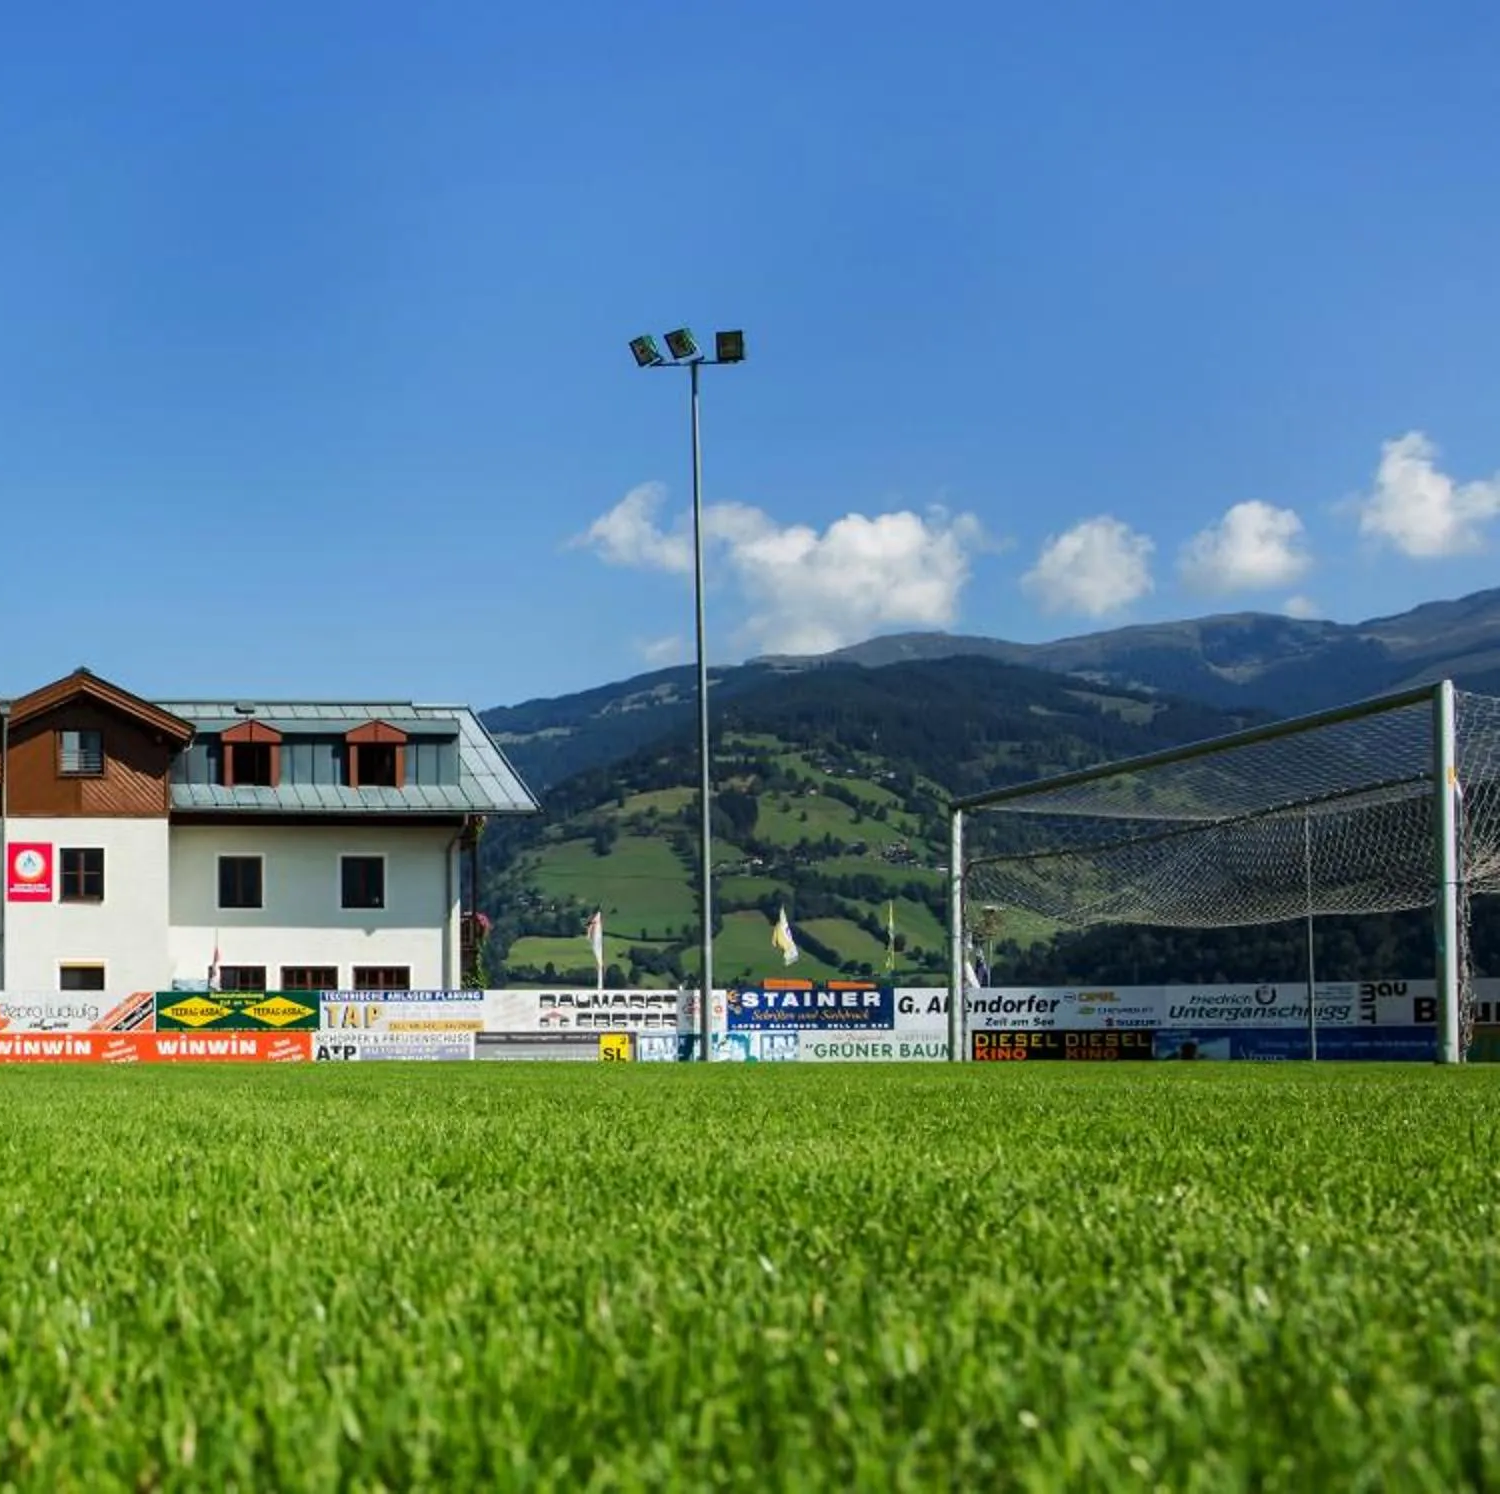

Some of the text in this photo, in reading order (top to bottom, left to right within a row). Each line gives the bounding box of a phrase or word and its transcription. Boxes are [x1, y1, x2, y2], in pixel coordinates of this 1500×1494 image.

[325, 992, 481, 1001] TECHNISCHE ANLAGEN PLANUNG
[539, 994, 677, 1008] BAUMARKT
[742, 992, 881, 1007] STAINER
[46, 1003, 99, 1020] Ludwig
[898, 996, 921, 1013] G.
[325, 1003, 381, 1028] TAP
[985, 1017, 1007, 1026] Zell
[1033, 1017, 1054, 1026] See
[975, 1033, 1058, 1047] DIESEL
[1065, 1033, 1149, 1047] DIESEL
[976, 1048, 1027, 1060] KINO
[1066, 1048, 1118, 1060] KINO
